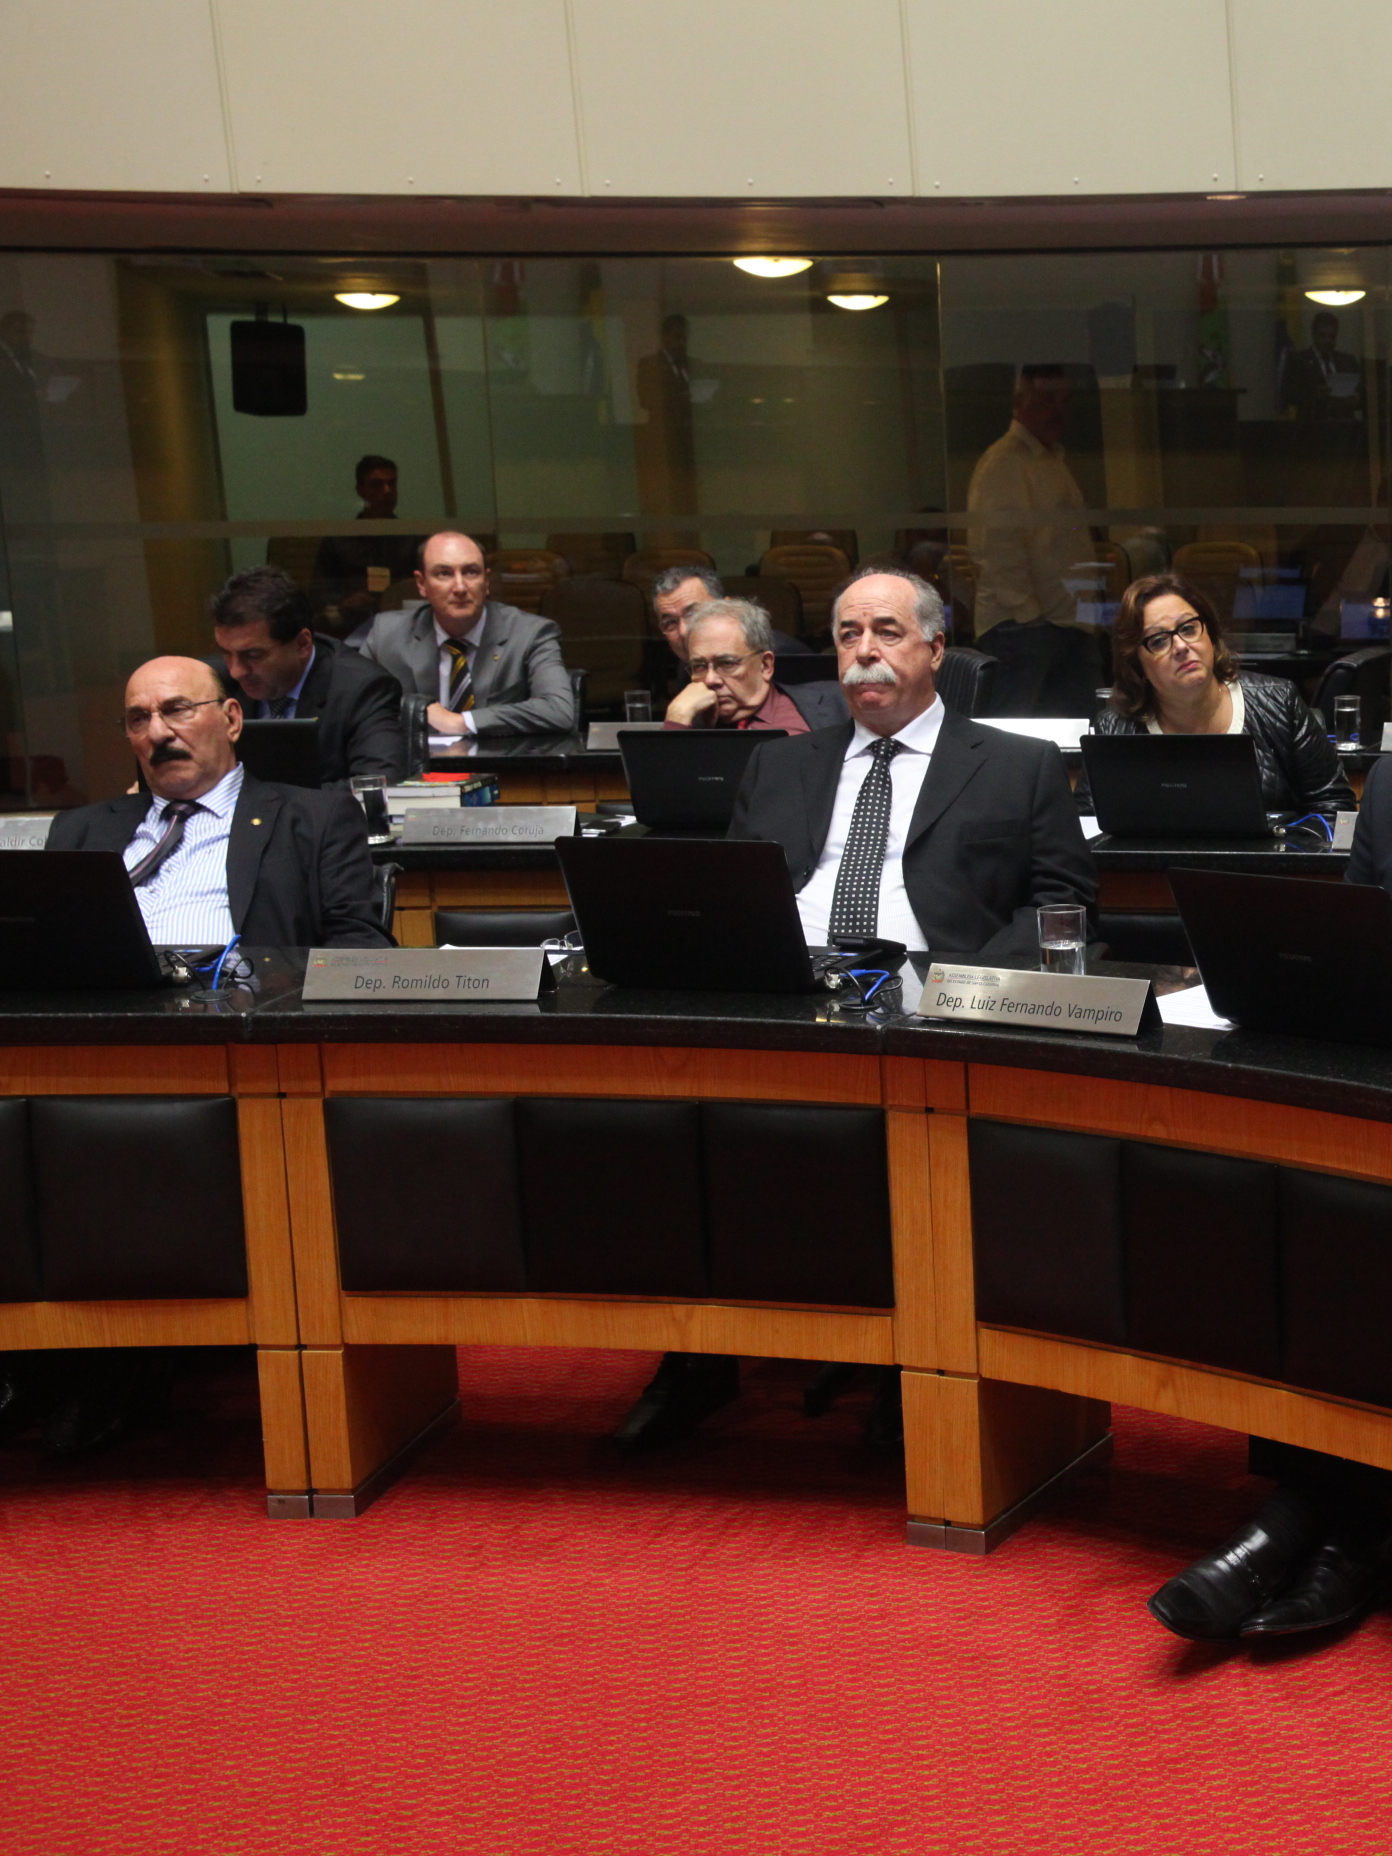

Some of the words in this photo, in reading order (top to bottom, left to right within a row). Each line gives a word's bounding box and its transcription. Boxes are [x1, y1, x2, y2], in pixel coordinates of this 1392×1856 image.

[432, 825, 455, 838] Dep.
[460, 825, 508, 836] Fernando
[511, 824, 544, 837] Coruja
[354, 975, 387, 992] Dep.
[392, 975, 450, 989] Romildo
[455, 975, 490, 989] Titon
[936, 992, 965, 1011] Dep.
[970, 995, 996, 1011] Luiz
[1000, 997, 1062, 1017] Fernando
[1067, 1003, 1123, 1024] Vampiro
